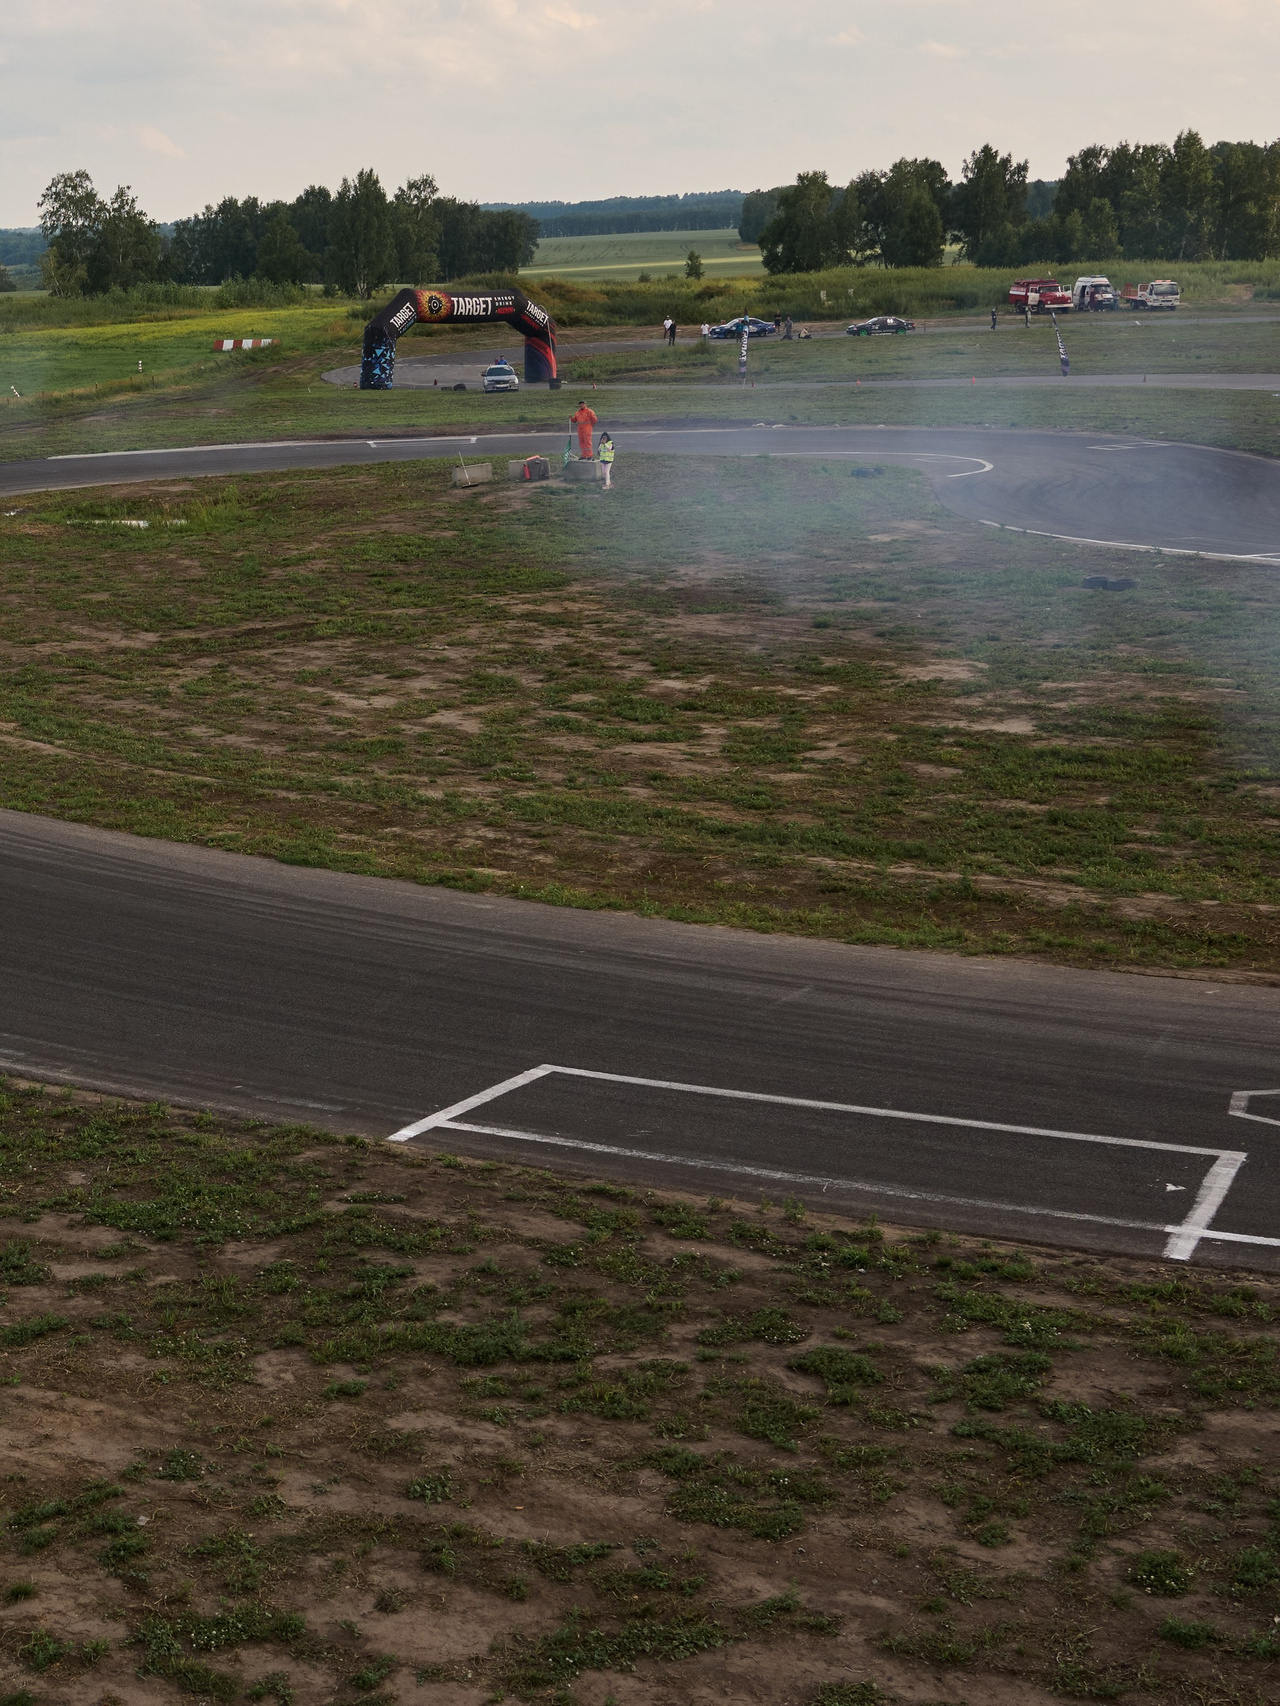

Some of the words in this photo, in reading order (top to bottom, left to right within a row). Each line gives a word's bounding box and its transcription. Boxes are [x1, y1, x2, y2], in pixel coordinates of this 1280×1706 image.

[389, 302, 415, 328] TARGET
[451, 297, 492, 316] TARGET
[526, 300, 549, 325] TARGET
